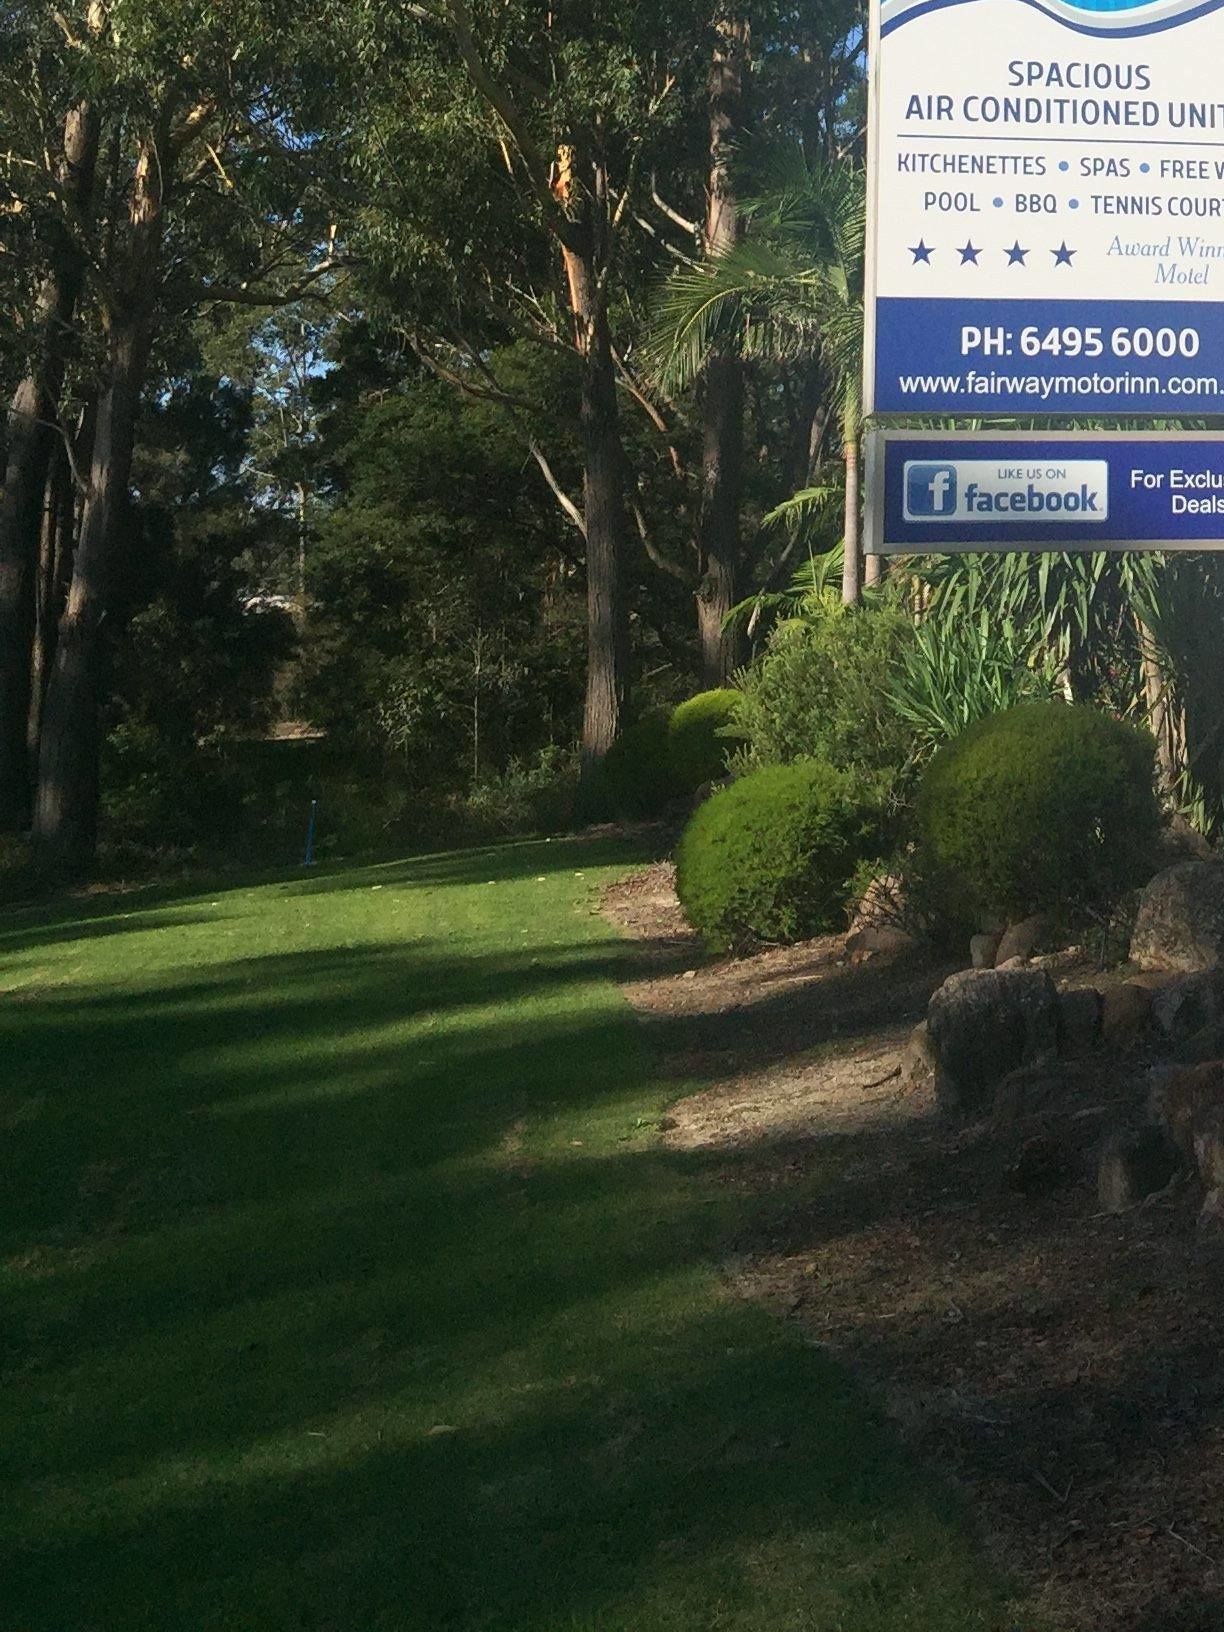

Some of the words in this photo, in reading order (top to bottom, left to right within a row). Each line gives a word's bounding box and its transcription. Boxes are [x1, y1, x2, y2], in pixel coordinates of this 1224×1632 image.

[1008, 60, 1151, 90] SPACIOUS
[905, 94, 953, 121] AIR
[963, 96, 1160, 127] CONDITIONED
[897, 153, 1047, 176] KITCHENETTES
[1080, 157, 1130, 178] SPAS
[1160, 159, 1210, 180] FREE
[924, 191, 981, 212] POOL
[1015, 193, 1057, 215] BBQ
[1091, 195, 1163, 216] TENNIS
[1106, 235, 1170, 257] Award
[1154, 264, 1210, 285] Motel
[960, 326, 1013, 356] PH:
[1020, 326, 1103, 357] 6495
[1111, 327, 1200, 358] 6000
[998, 468, 1023, 480] LIKE
[1026, 468, 1042, 480] US
[1045, 468, 1067, 480] ON
[1131, 470, 1165, 489] For
[964, 483, 1098, 512] facebook
